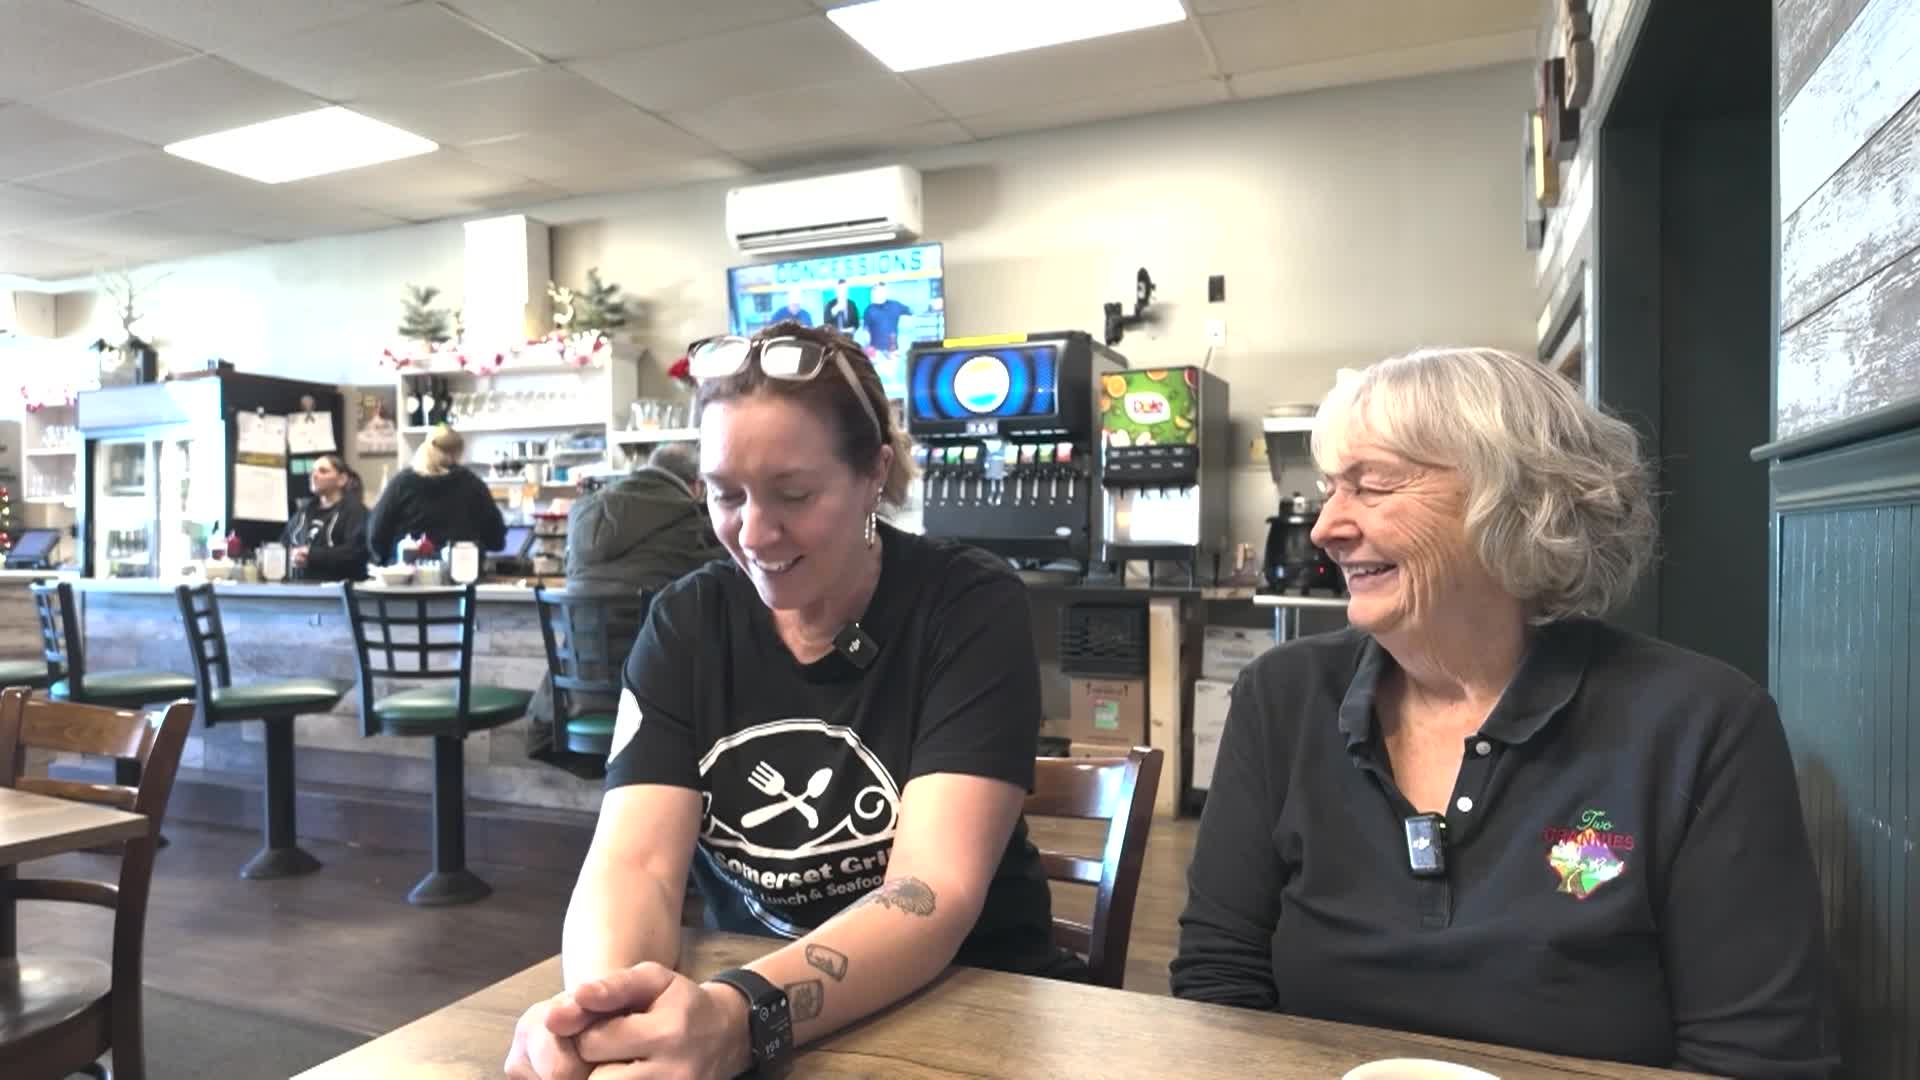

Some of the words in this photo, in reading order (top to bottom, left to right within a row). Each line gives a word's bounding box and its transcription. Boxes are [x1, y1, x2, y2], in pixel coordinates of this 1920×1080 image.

[777, 251, 920, 283] CONCESSIONS
[1577, 810, 1613, 831] Two
[714, 852, 832, 889] Somerset
[827, 875, 882, 896] Seafoo
